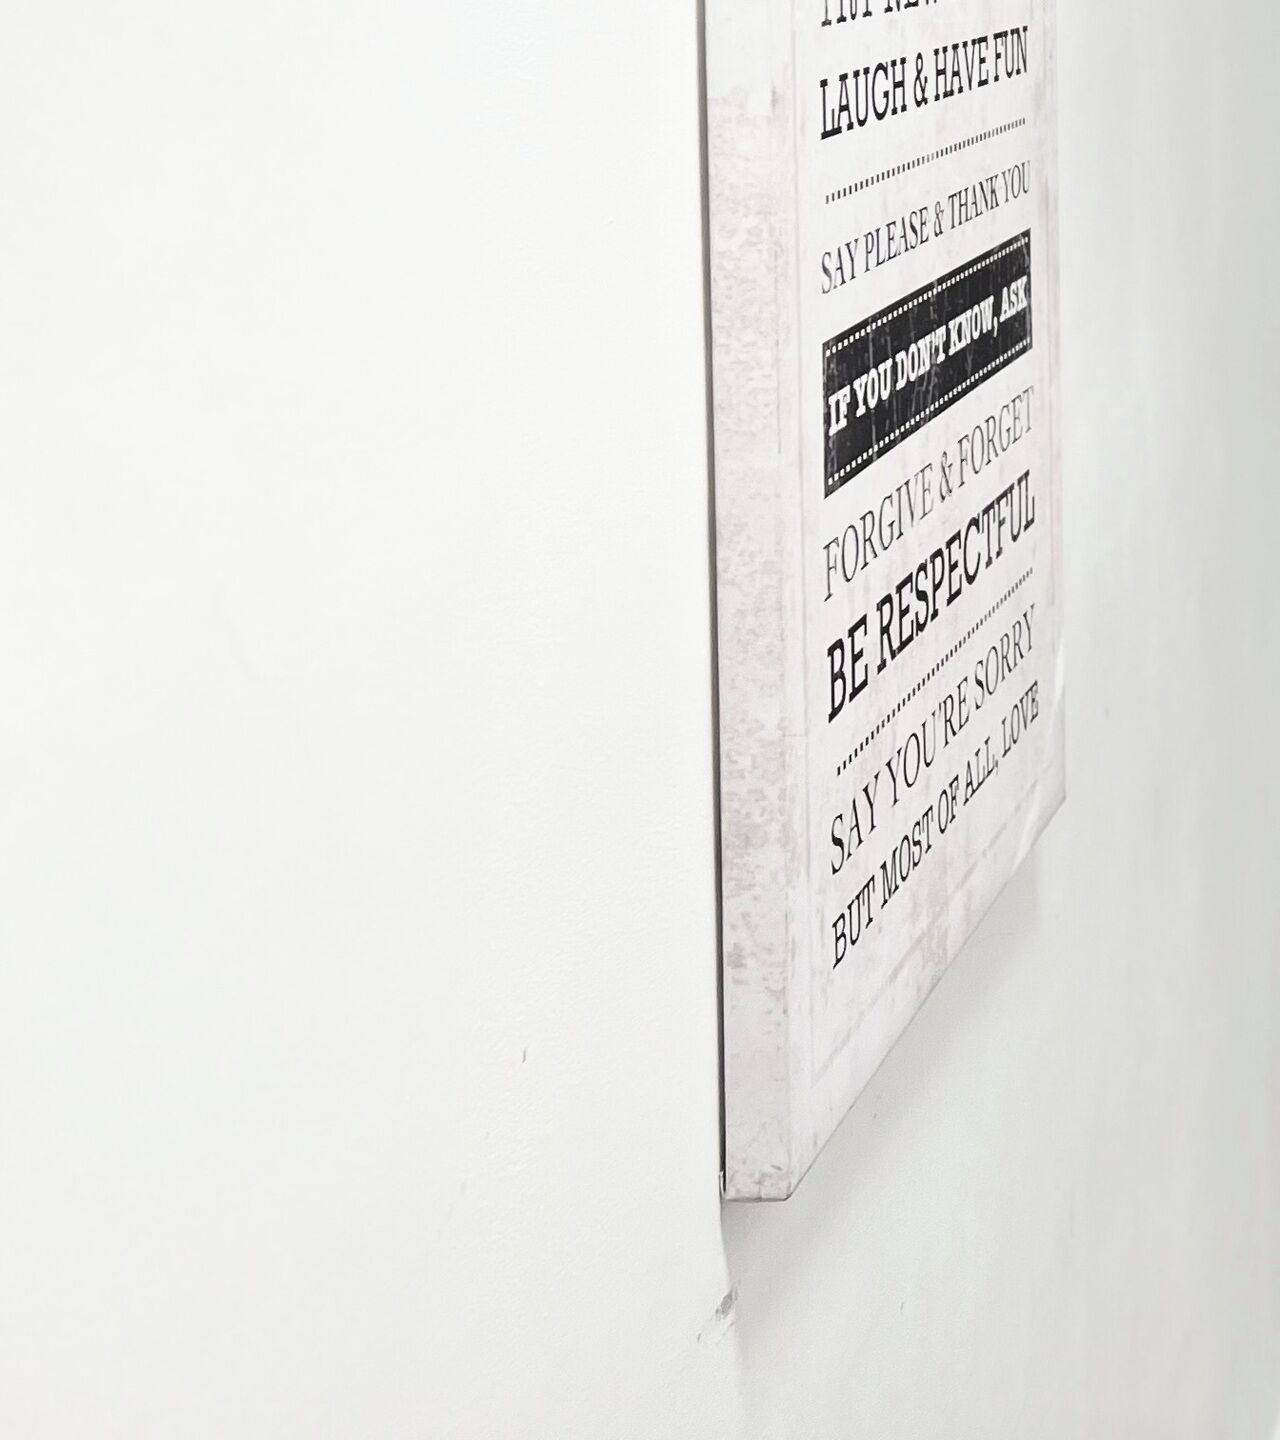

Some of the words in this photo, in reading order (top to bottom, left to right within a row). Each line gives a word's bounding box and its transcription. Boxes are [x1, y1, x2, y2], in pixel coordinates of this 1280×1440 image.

[819, 56, 908, 141] LAUGH
[913, 51, 929, 108] &
[933, 35, 989, 102] HAVE
[993, 25, 1029, 83] FUN
[821, 237, 859, 295] SAY
[863, 206, 930, 274] PLEASE
[933, 200, 945, 238] &
[947, 172, 1000, 230] THANK
[1001, 159, 1032, 204] YOU
[827, 384, 852, 437] IF
[853, 358, 893, 418] YOU
[895, 324, 947, 392] DON'T
[948, 295, 999, 357] KNOW,
[999, 275, 1028, 324] ASK
[823, 462, 934, 603] FORGIVE
[939, 450, 954, 504] &
[957, 385, 1036, 490] FORGET
[827, 613, 869, 724] BE
[876, 468, 1036, 676] RESPECTFUL
[830, 769, 881, 876] SAY
[885, 674, 970, 808] YOU'RE
[973, 602, 1036, 712] SORRY
[831, 874, 876, 971] BUT
[880, 804, 935, 910] MOST
[937, 773, 960, 836] OF
[963, 735, 1000, 807] ALL,
[1001, 679, 1040, 759] LOVE
